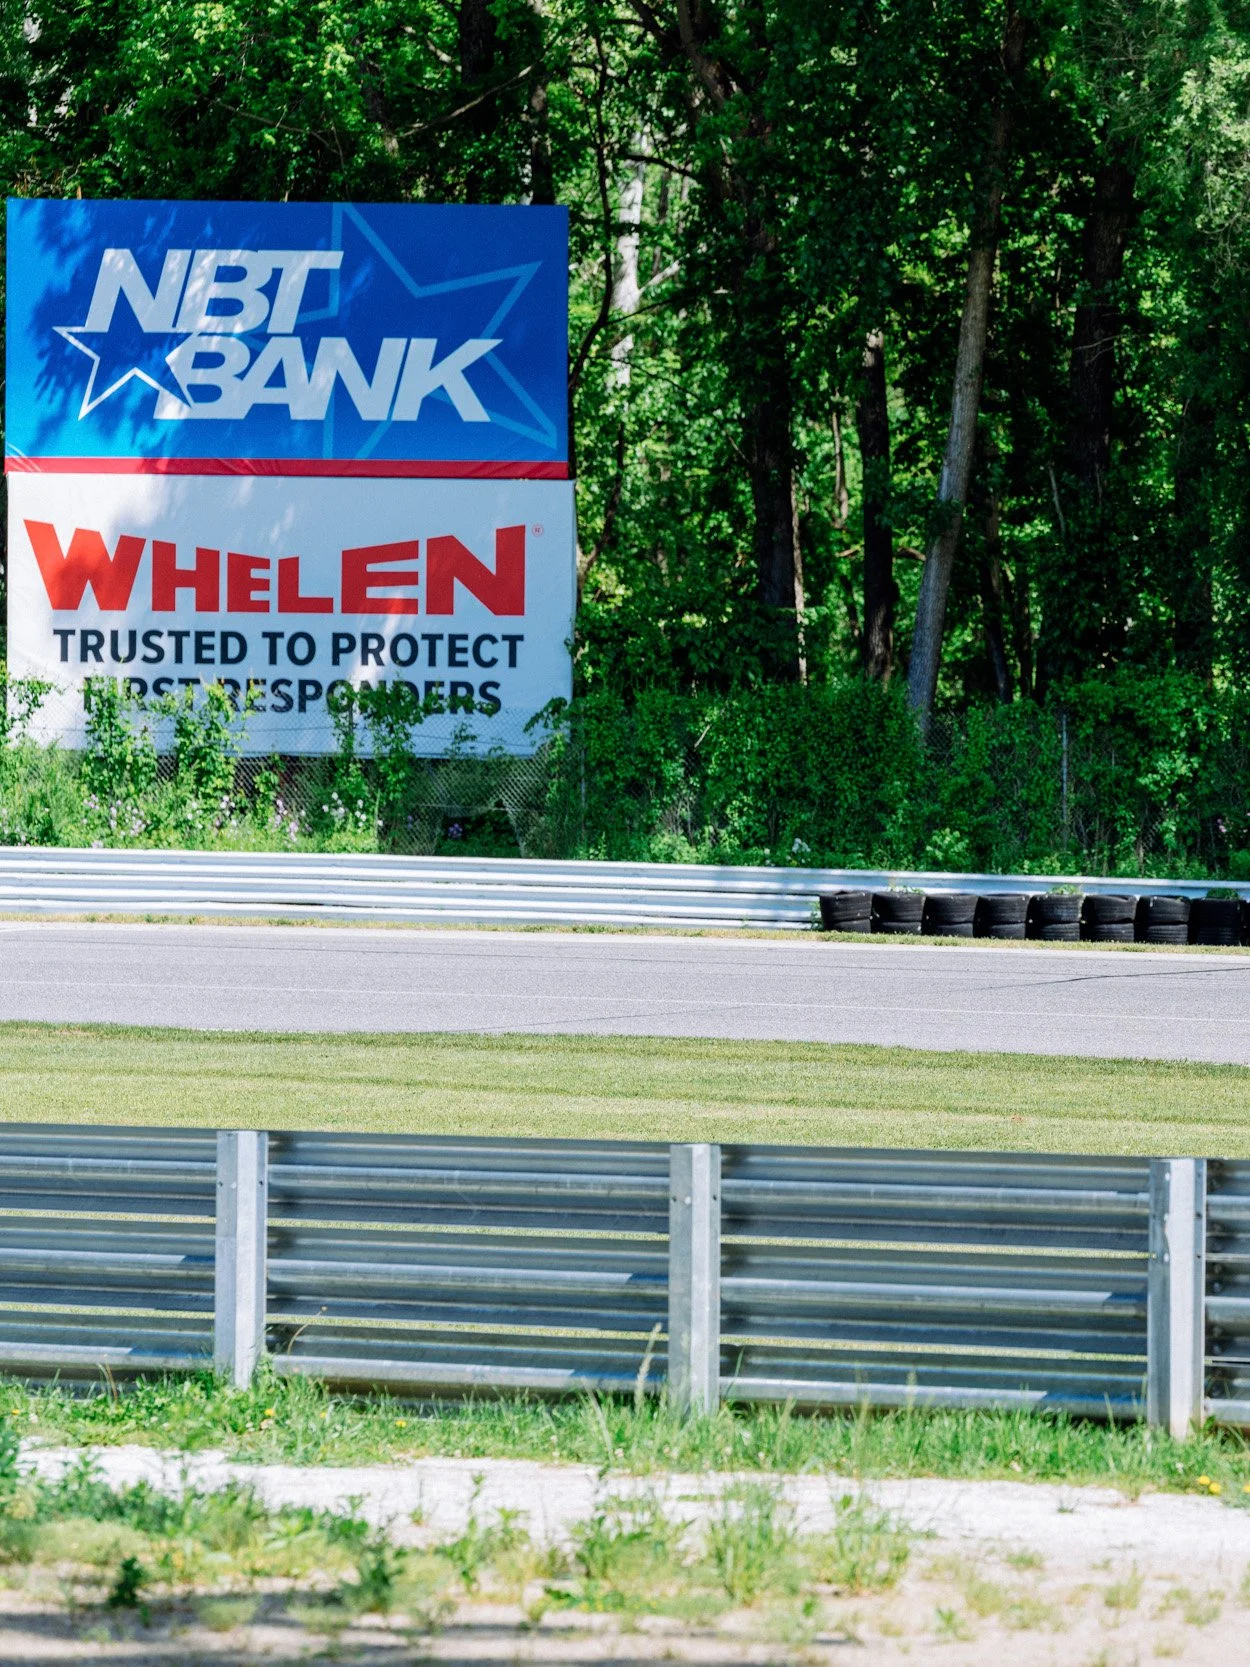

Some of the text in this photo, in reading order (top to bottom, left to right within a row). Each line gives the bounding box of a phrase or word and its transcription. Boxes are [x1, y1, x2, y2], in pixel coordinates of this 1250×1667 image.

[85, 248, 345, 334] NBT
[154, 335, 504, 422] BANK
[23, 519, 527, 616] WHELEN
[53, 629, 524, 668] TRUSTED TO PROTECT
[83, 676, 200, 713] FRST
